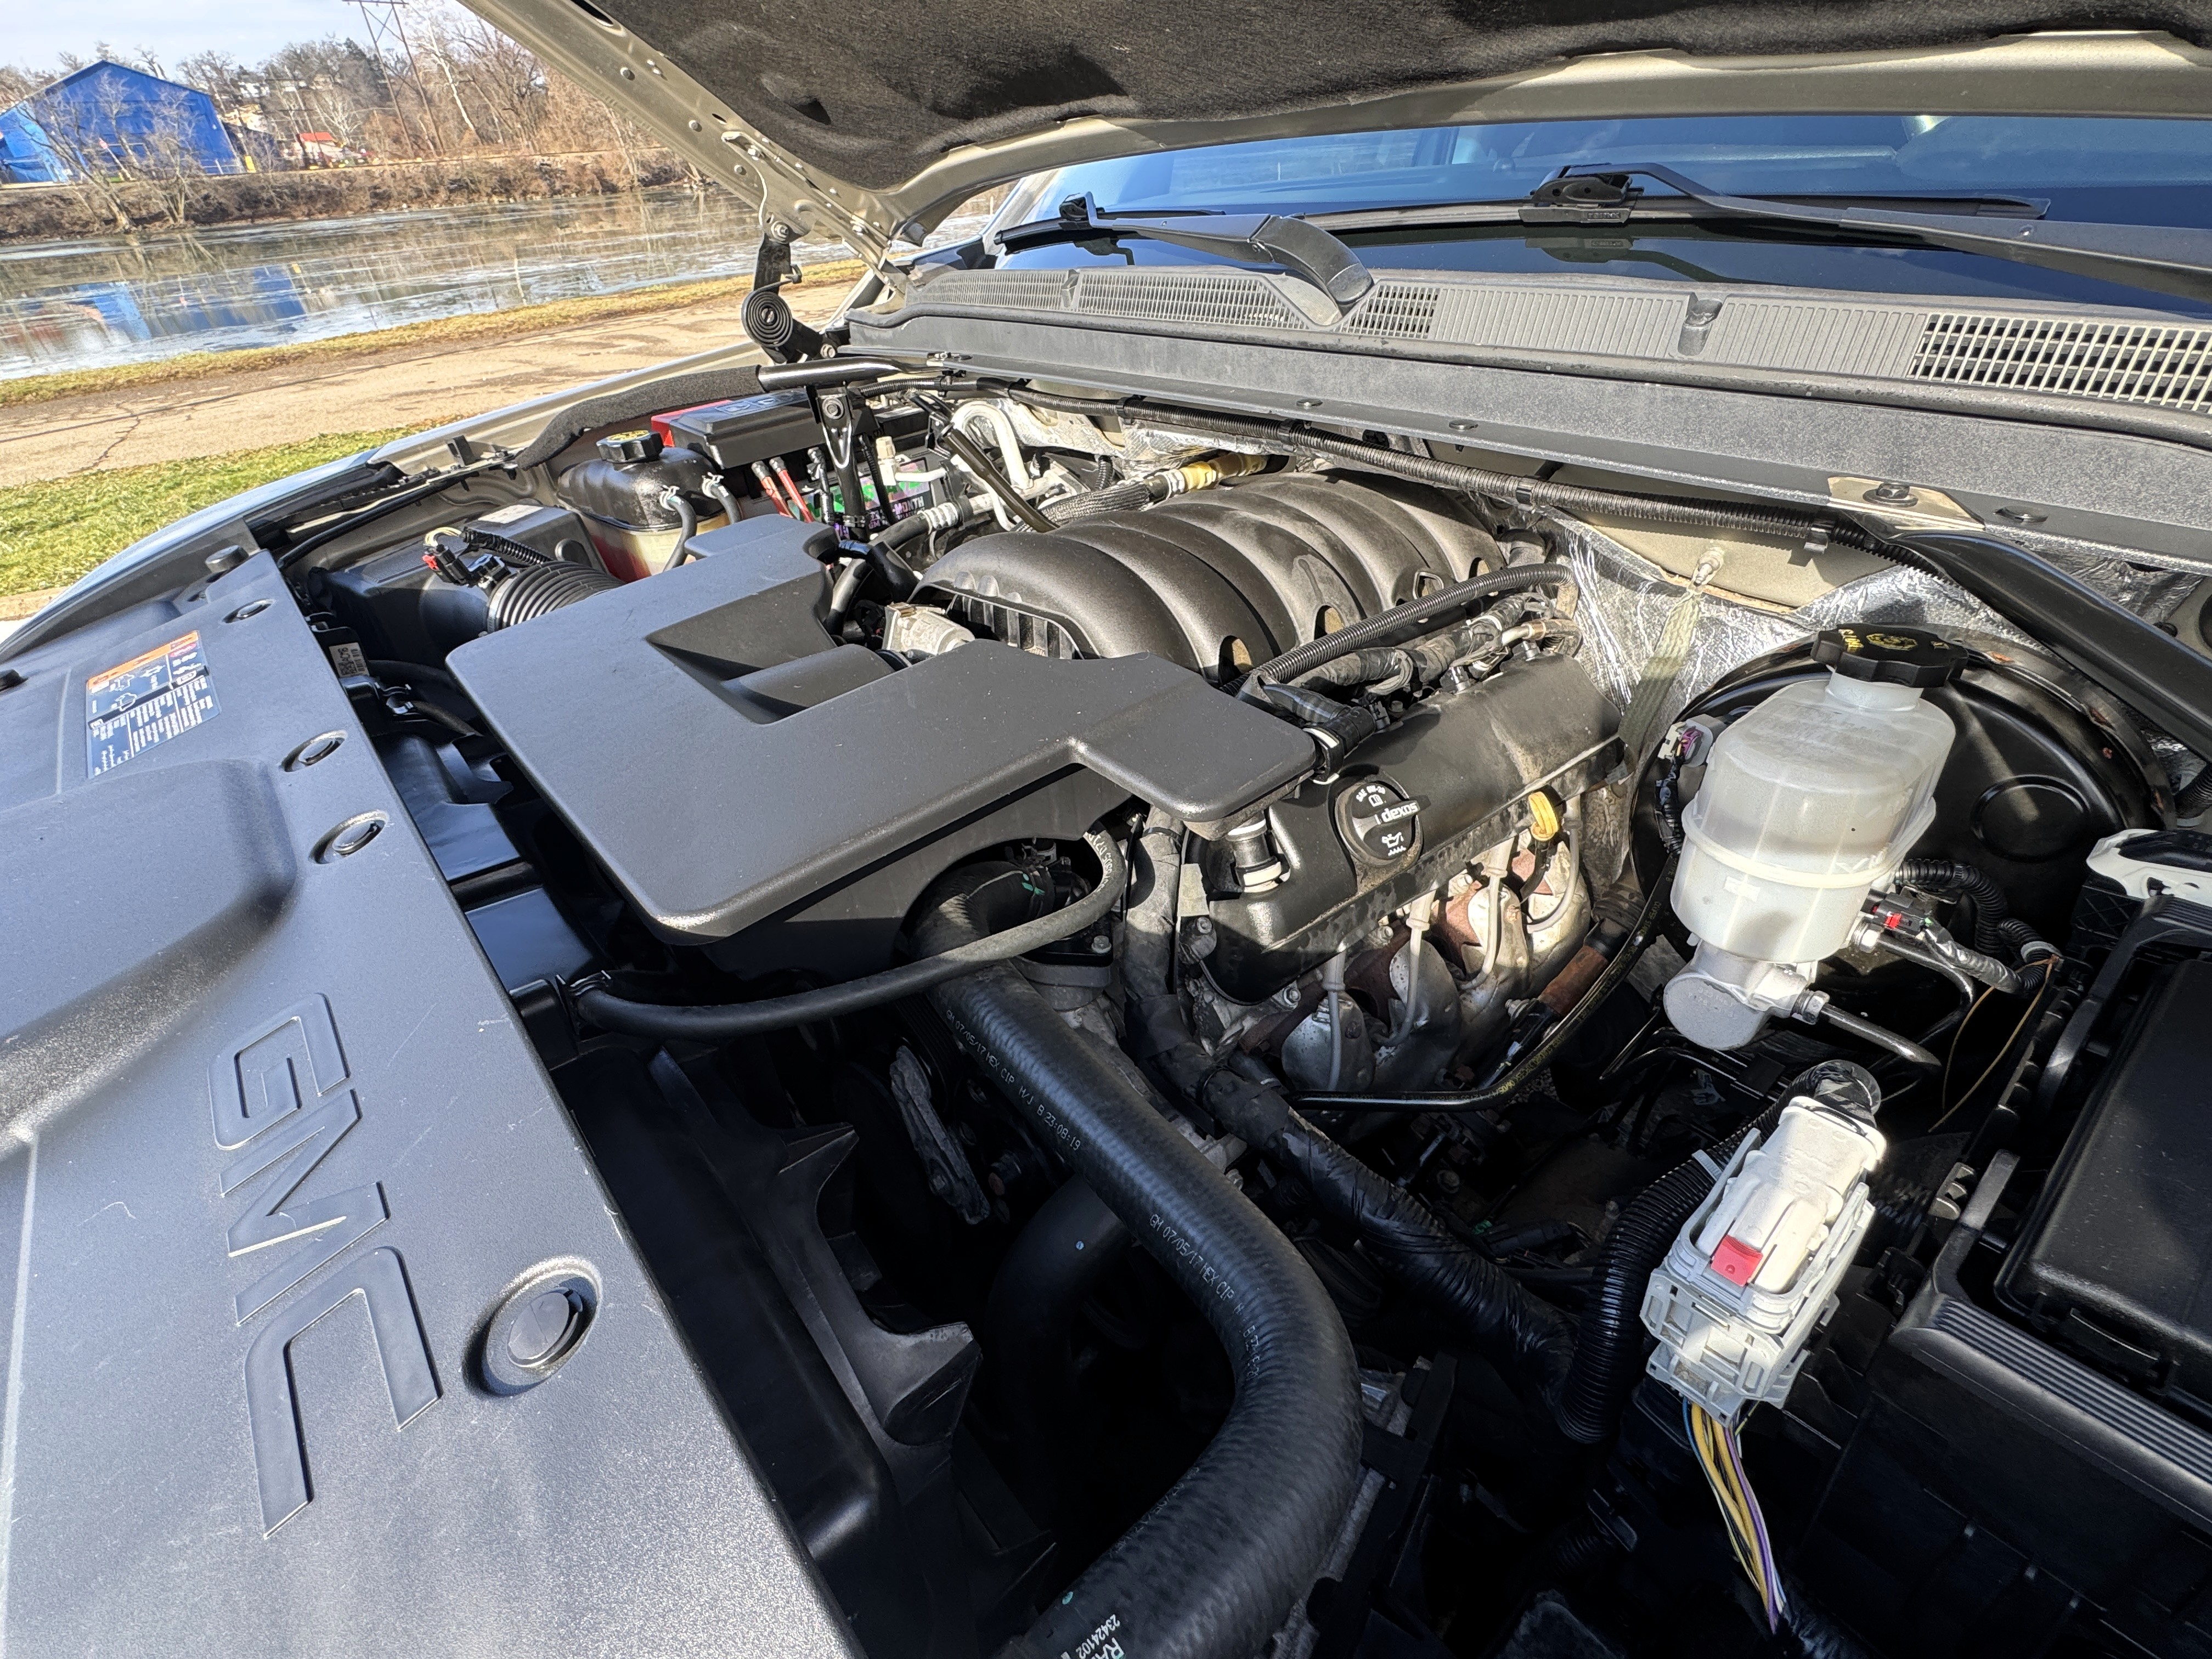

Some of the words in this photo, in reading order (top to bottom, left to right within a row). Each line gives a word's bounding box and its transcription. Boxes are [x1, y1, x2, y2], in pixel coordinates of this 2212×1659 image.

[1356, 788, 1368, 802] SAE
[1381, 802, 1419, 822] dexos
[955, 1020, 986, 1055] 07/05/17
[985, 1051, 1001, 1072] MEX
[1001, 1068, 1016, 1085] CIP
[1043, 1111, 1082, 1151] 23:08:19
[208, 992, 443, 1538] GMC
[1149, 1213, 1165, 1232] GM
[1163, 1226, 1204, 1269] 07/05/17
[1198, 1262, 1220, 1287] MEX
[1216, 1280, 1235, 1301] CIP
[1075, 1613, 1120, 1659] 23424102
